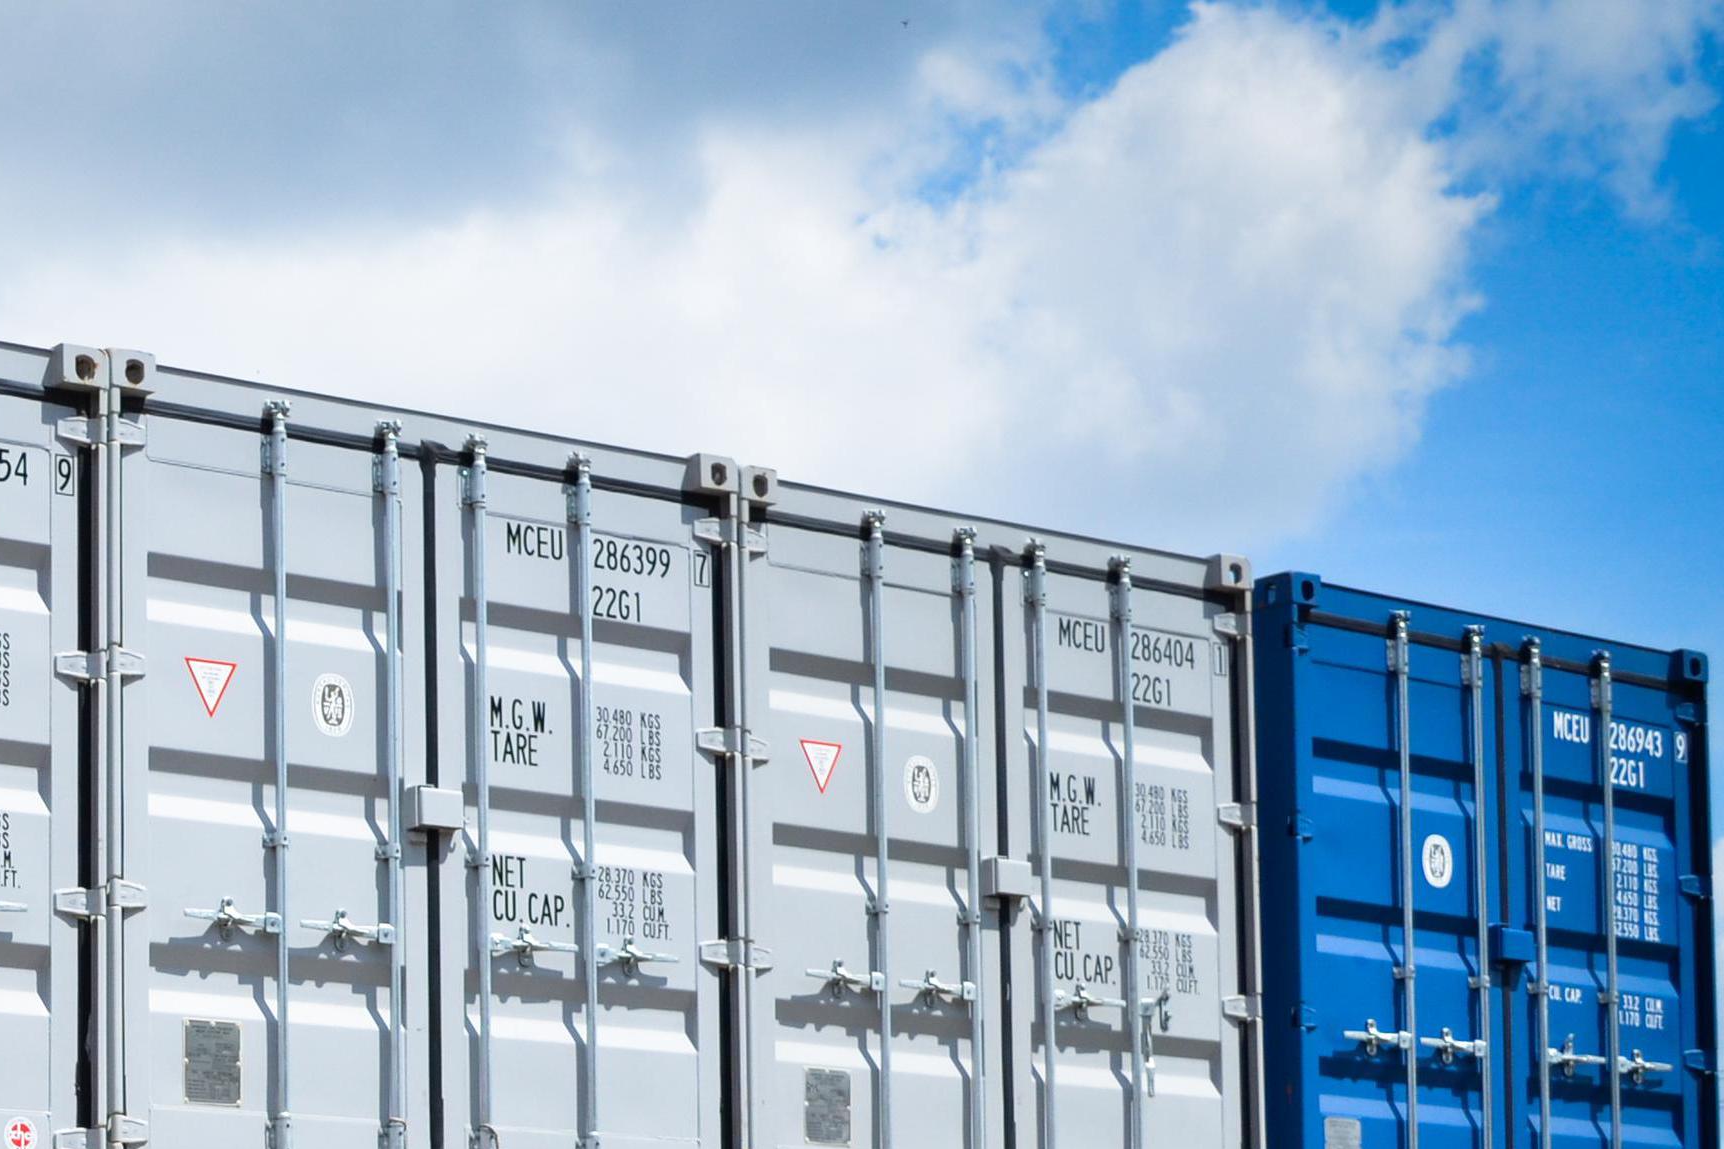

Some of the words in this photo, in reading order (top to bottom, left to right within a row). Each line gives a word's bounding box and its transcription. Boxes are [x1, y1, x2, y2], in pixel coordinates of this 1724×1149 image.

[58, 459, 71, 491] 9
[507, 521, 563, 560] MCEU
[594, 538, 670, 578] 286399
[696, 554, 706, 584] 7
[593, 586, 640, 622] 22G1
[1059, 618, 1105, 653] MCEU
[1131, 632, 1194, 669] 286404
[1217, 646, 1222, 673] 1
[1131, 673, 1171, 706] 22G1
[492, 730, 538, 766] TARE
[1554, 711, 1589, 744] MCEU
[1609, 722, 1662, 758] 286943
[1676, 734, 1684, 760] 9
[1610, 757, 1644, 788] 22G1
[1051, 804, 1090, 835] TARE
[492, 854, 526, 889] NET
[1053, 920, 1081, 950] NET
